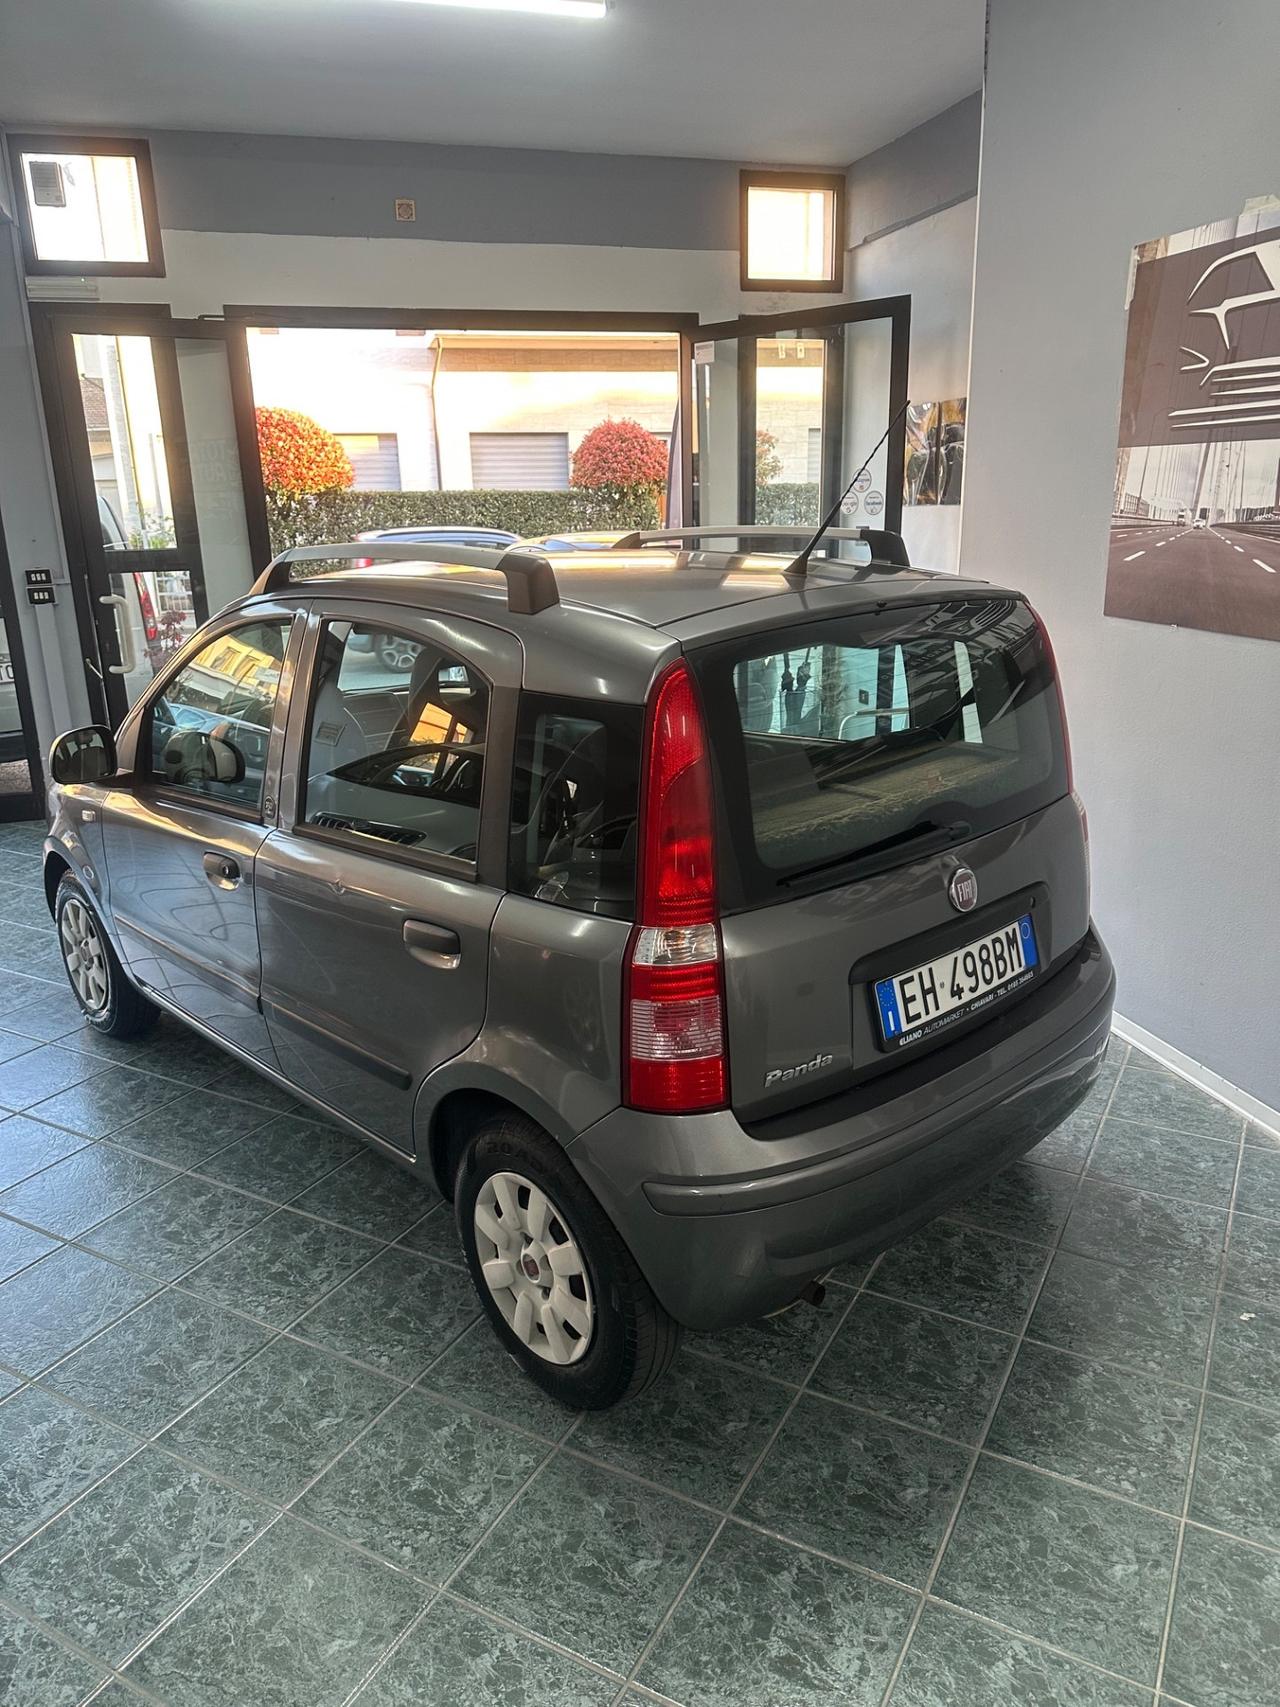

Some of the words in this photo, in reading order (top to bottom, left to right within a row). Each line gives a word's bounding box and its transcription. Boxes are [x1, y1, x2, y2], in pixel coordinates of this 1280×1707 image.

[957, 880, 973, 902] FIAT
[899, 967, 940, 1025] EH
[950, 927, 1022, 1001] 498BM
[764, 1054, 833, 1089] Panda
